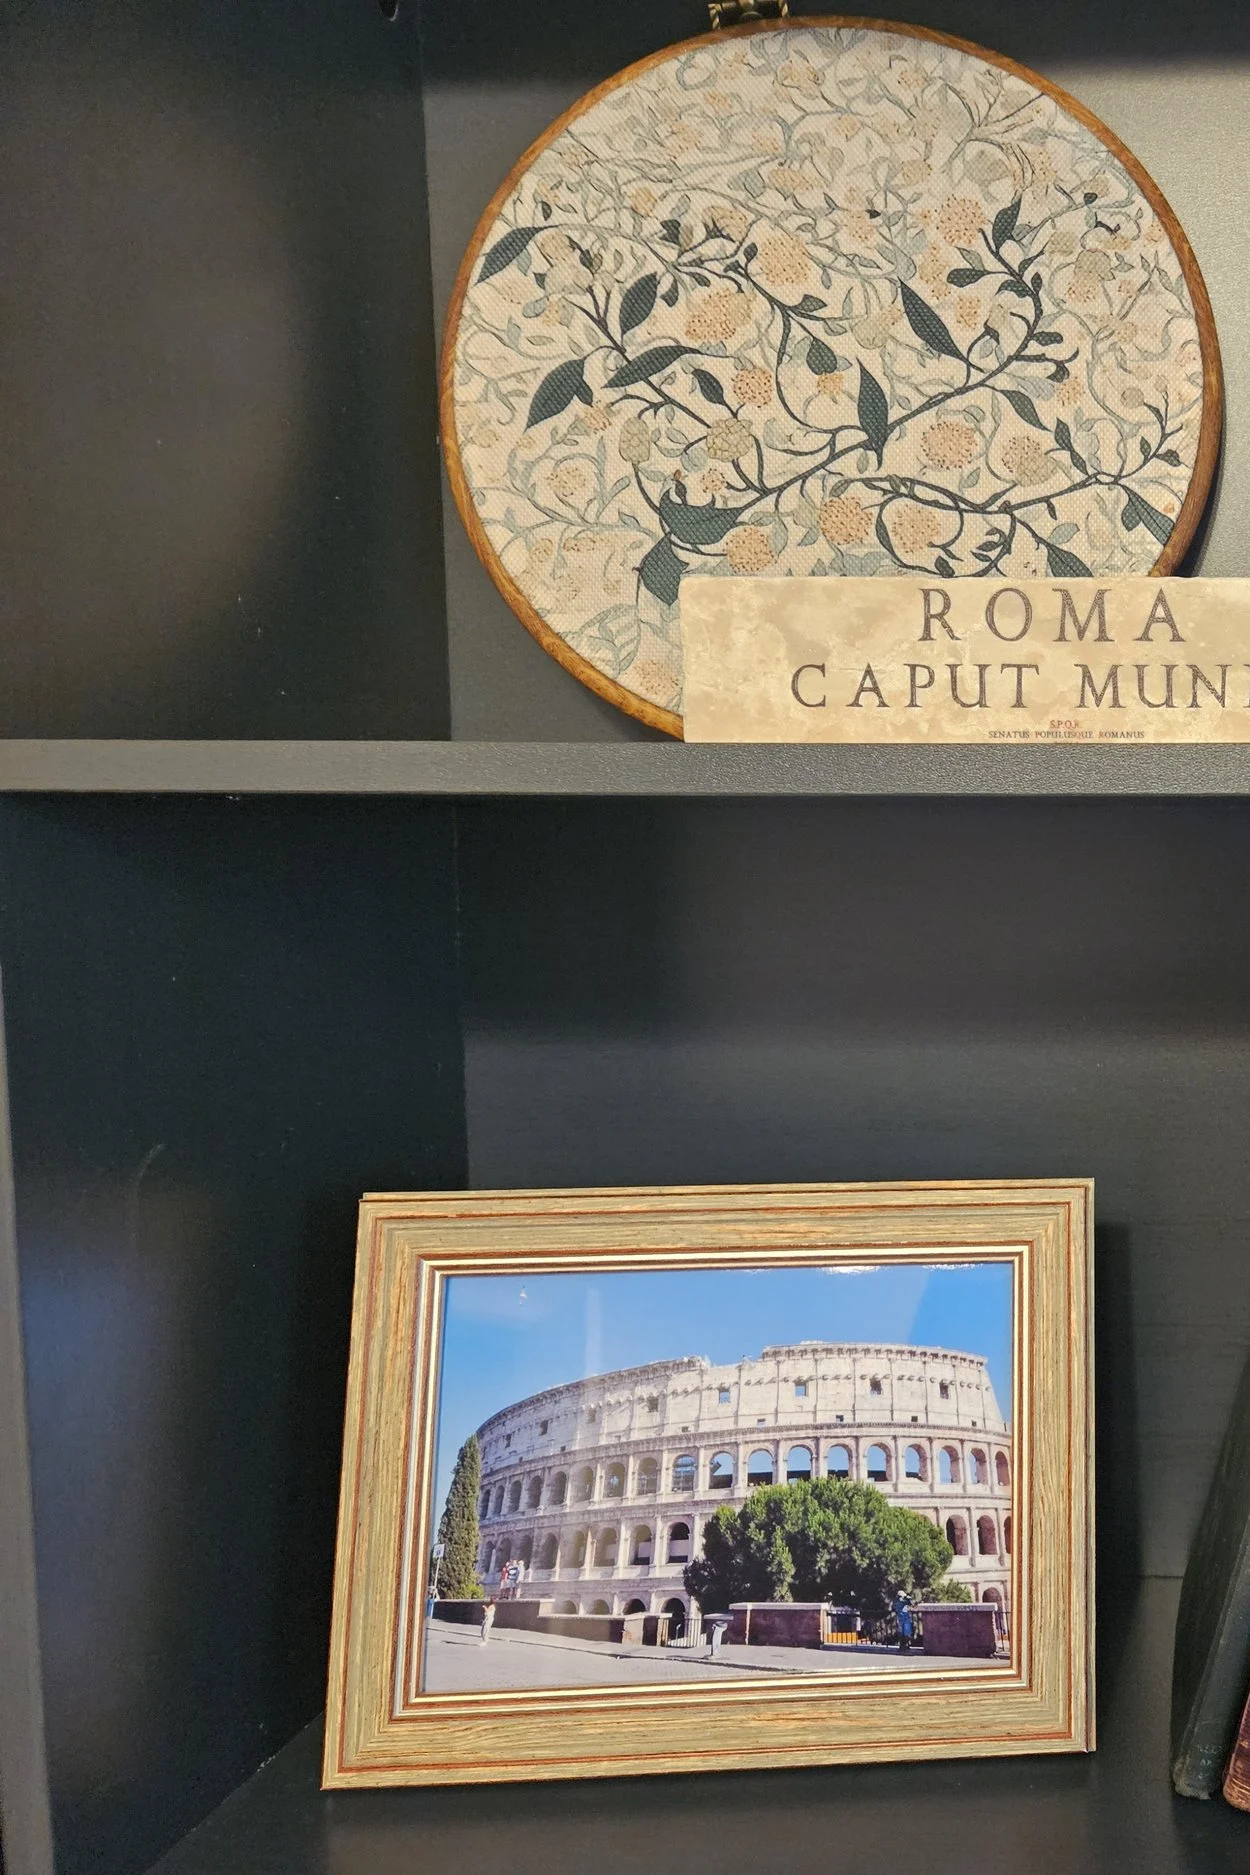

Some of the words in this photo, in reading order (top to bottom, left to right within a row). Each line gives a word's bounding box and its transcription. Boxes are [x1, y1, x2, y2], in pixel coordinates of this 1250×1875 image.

[917, 587, 1185, 642] ROMA
[790, 662, 1040, 709] CAPUT
[988, 731, 1030, 739] SENATUS
[1035, 731, 1094, 739] POPULUSQUE
[1098, 731, 1145, 739] ROMANUS
